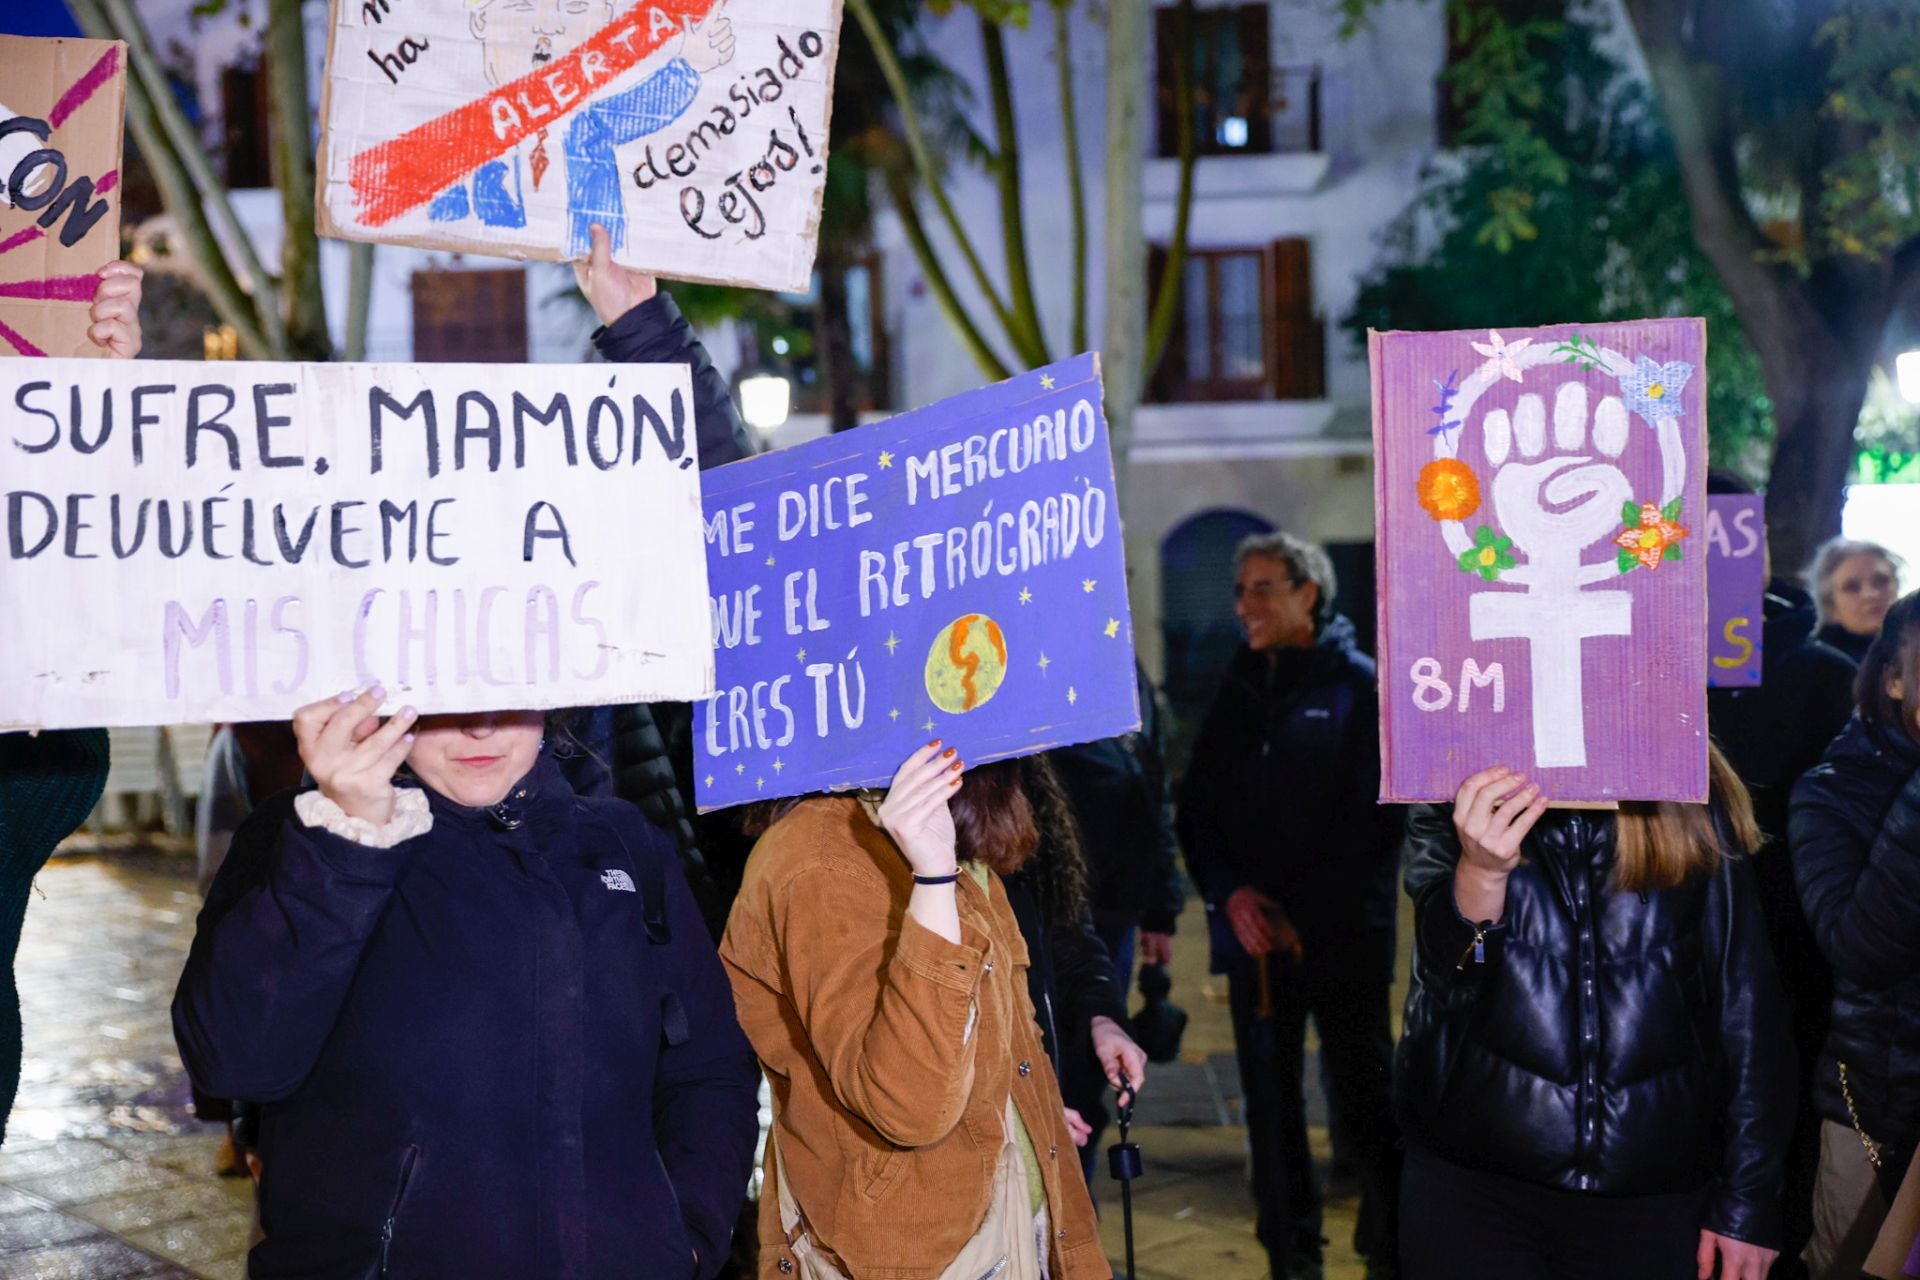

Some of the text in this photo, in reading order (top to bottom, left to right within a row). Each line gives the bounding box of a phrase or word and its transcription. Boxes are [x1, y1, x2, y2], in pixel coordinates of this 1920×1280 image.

[367, 37, 430, 85] ha
[491, 7, 676, 139] ALERTA
[633, 31, 823, 189] demasiado
[702, 399, 1095, 557] ME DICE MERCURIO
[523, 501, 577, 567] A
[163, 580, 609, 698] MIS CHICAS
[784, 568, 831, 635] EL
[705, 646, 866, 756] ERES TÚ
[1410, 657, 1504, 713] 8M
